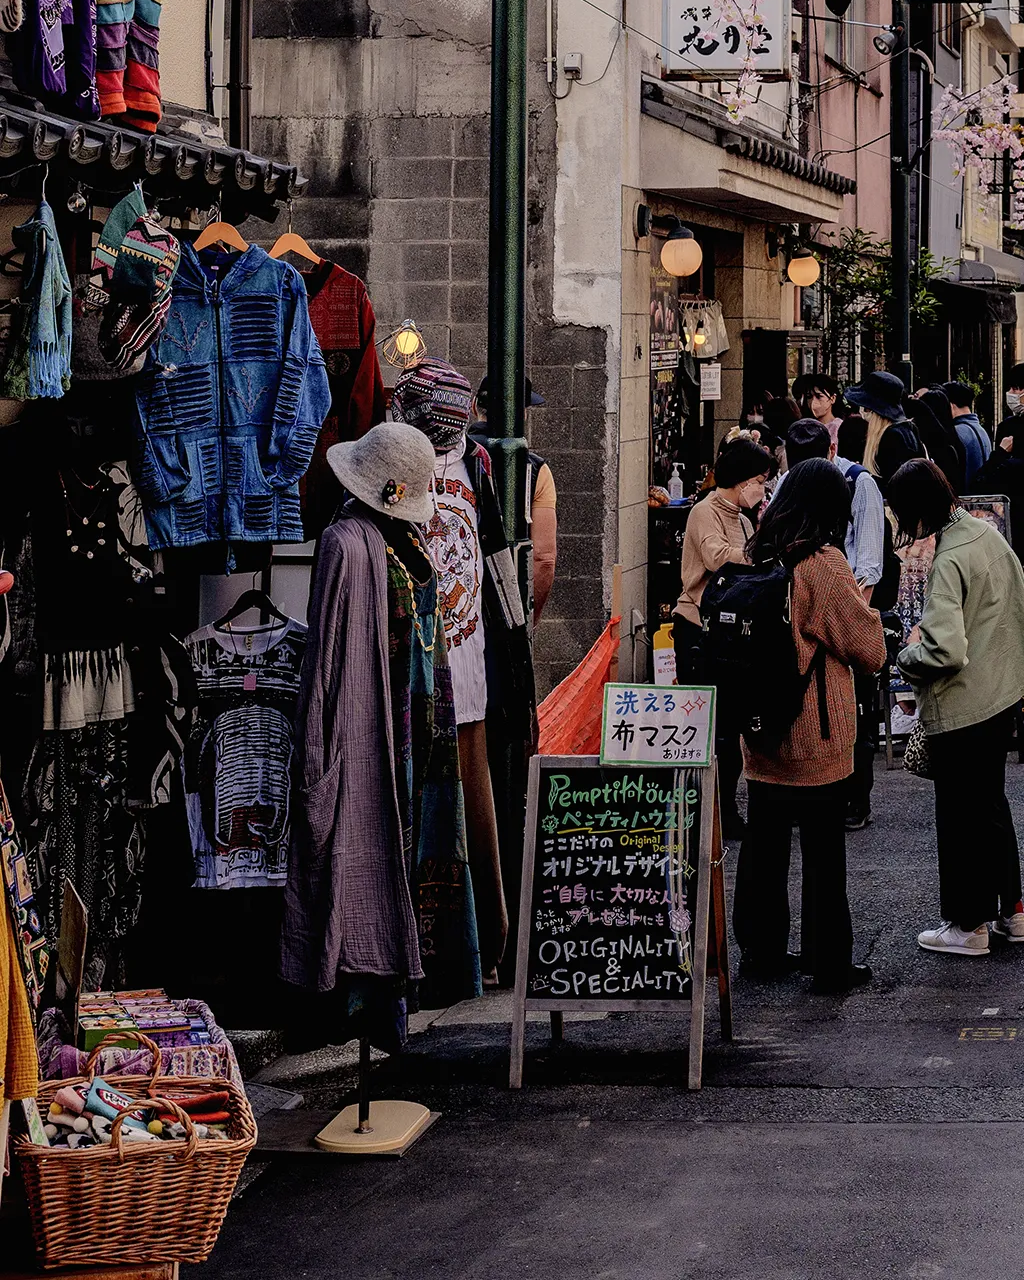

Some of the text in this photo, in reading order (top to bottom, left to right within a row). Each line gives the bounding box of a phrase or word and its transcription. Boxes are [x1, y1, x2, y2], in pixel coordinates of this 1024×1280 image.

[615, 691, 676, 716] 洗える
[611, 719, 698, 751] 布マスク
[562, 809, 678, 828] ペンプティハウス
[543, 835, 614, 853] ここだけの
[619, 834, 661, 849] Original
[542, 851, 684, 878] オリジナルデザイン
[543, 883, 604, 904] ご自身に
[538, 935, 690, 964] ORIGINALITY
[605, 957, 622, 976] &
[550, 965, 690, 995] SPECIALITY
